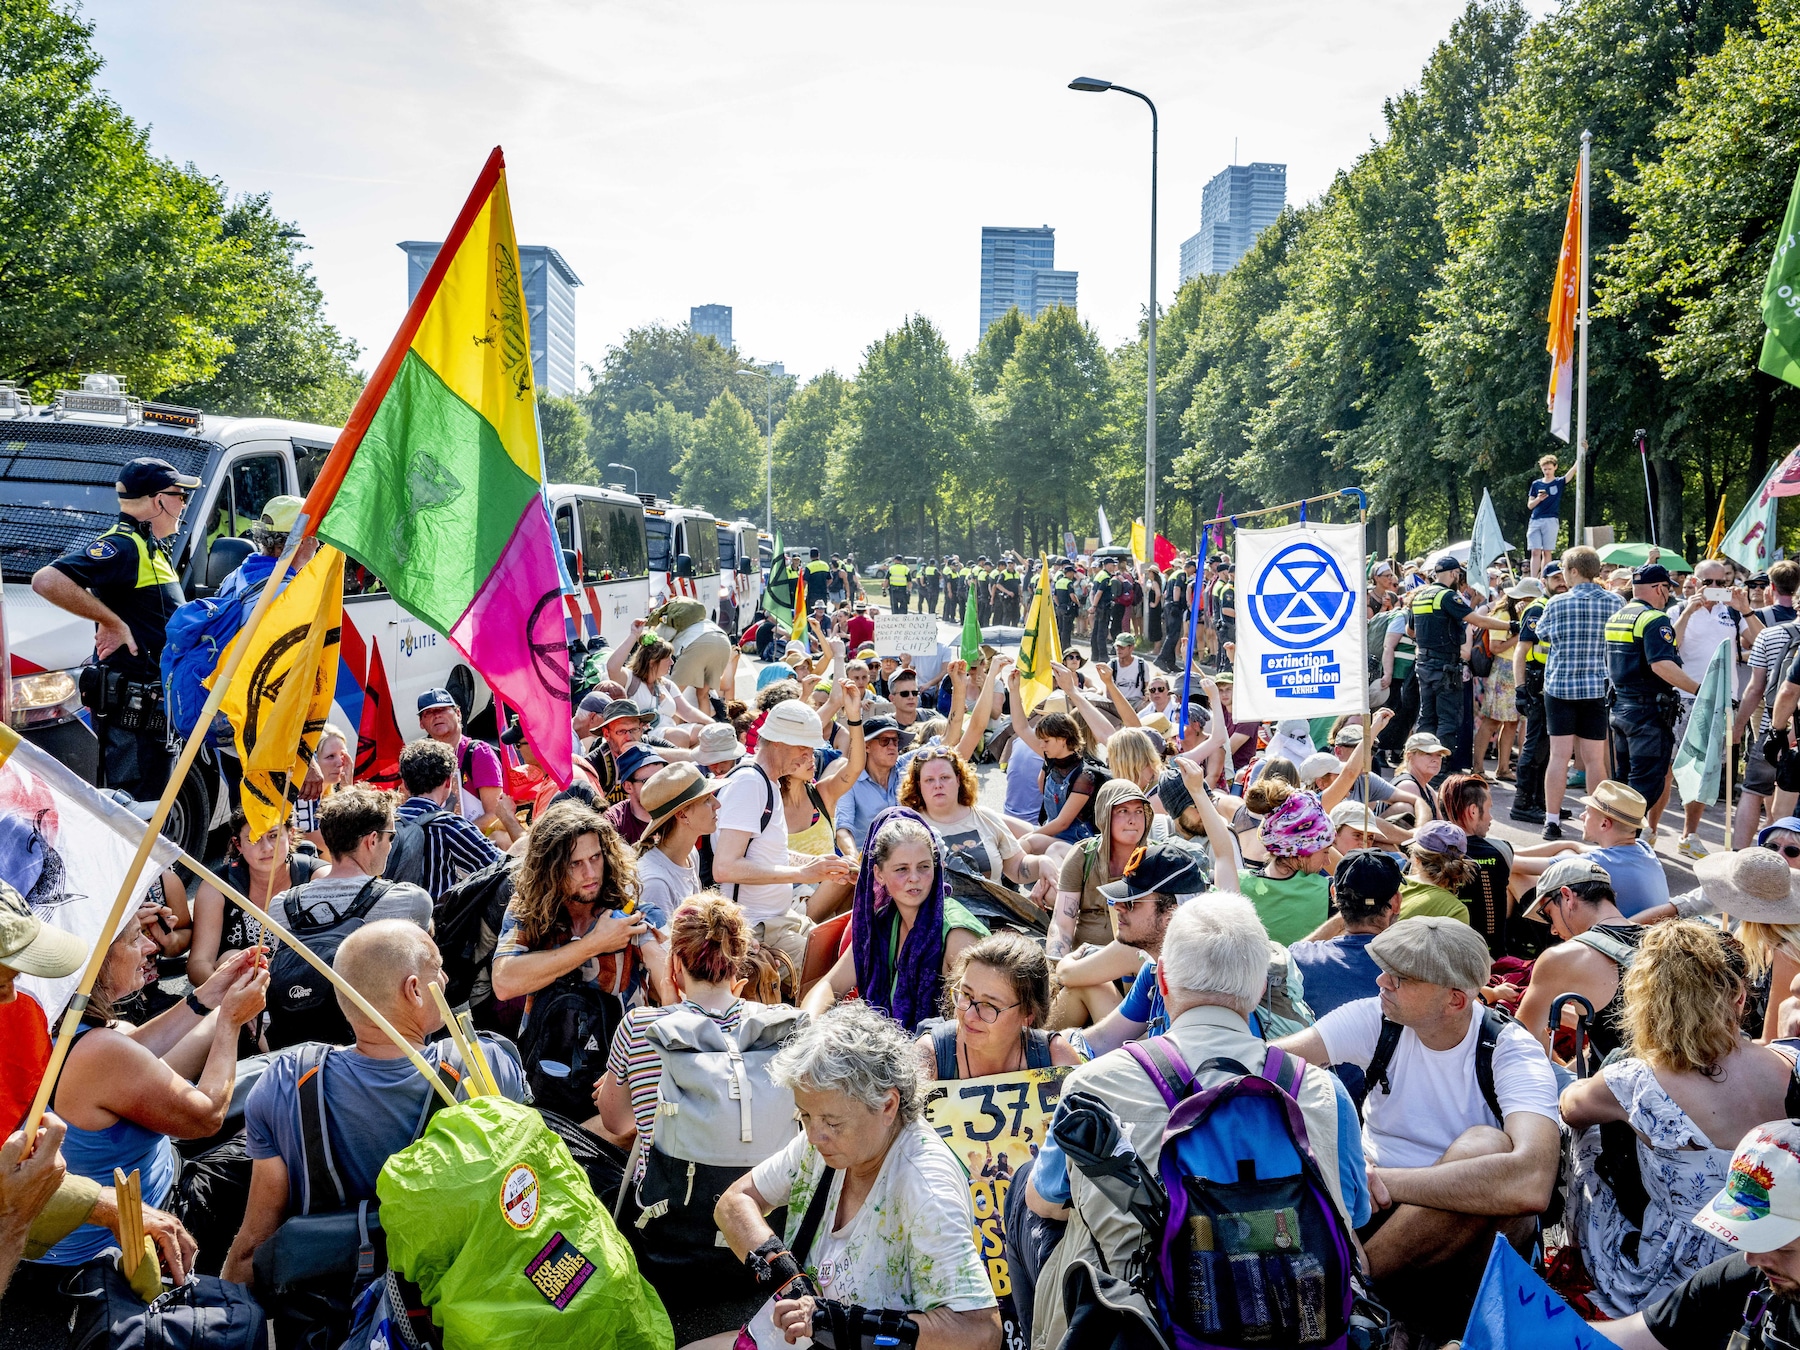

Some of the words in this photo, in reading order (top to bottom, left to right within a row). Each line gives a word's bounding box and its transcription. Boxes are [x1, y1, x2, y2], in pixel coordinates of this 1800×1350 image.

[401, 633, 436, 657] POLITIE
[1267, 652, 1328, 669] extinction
[1282, 666, 1339, 685] rebellion
[1291, 686, 1319, 695] ARNHEM
[1709, 1221, 1739, 1243] STOP
[531, 1259, 553, 1286] STOP
[539, 1252, 575, 1294] FOSSIELE
[546, 1254, 586, 1301] SUBSIDIES
